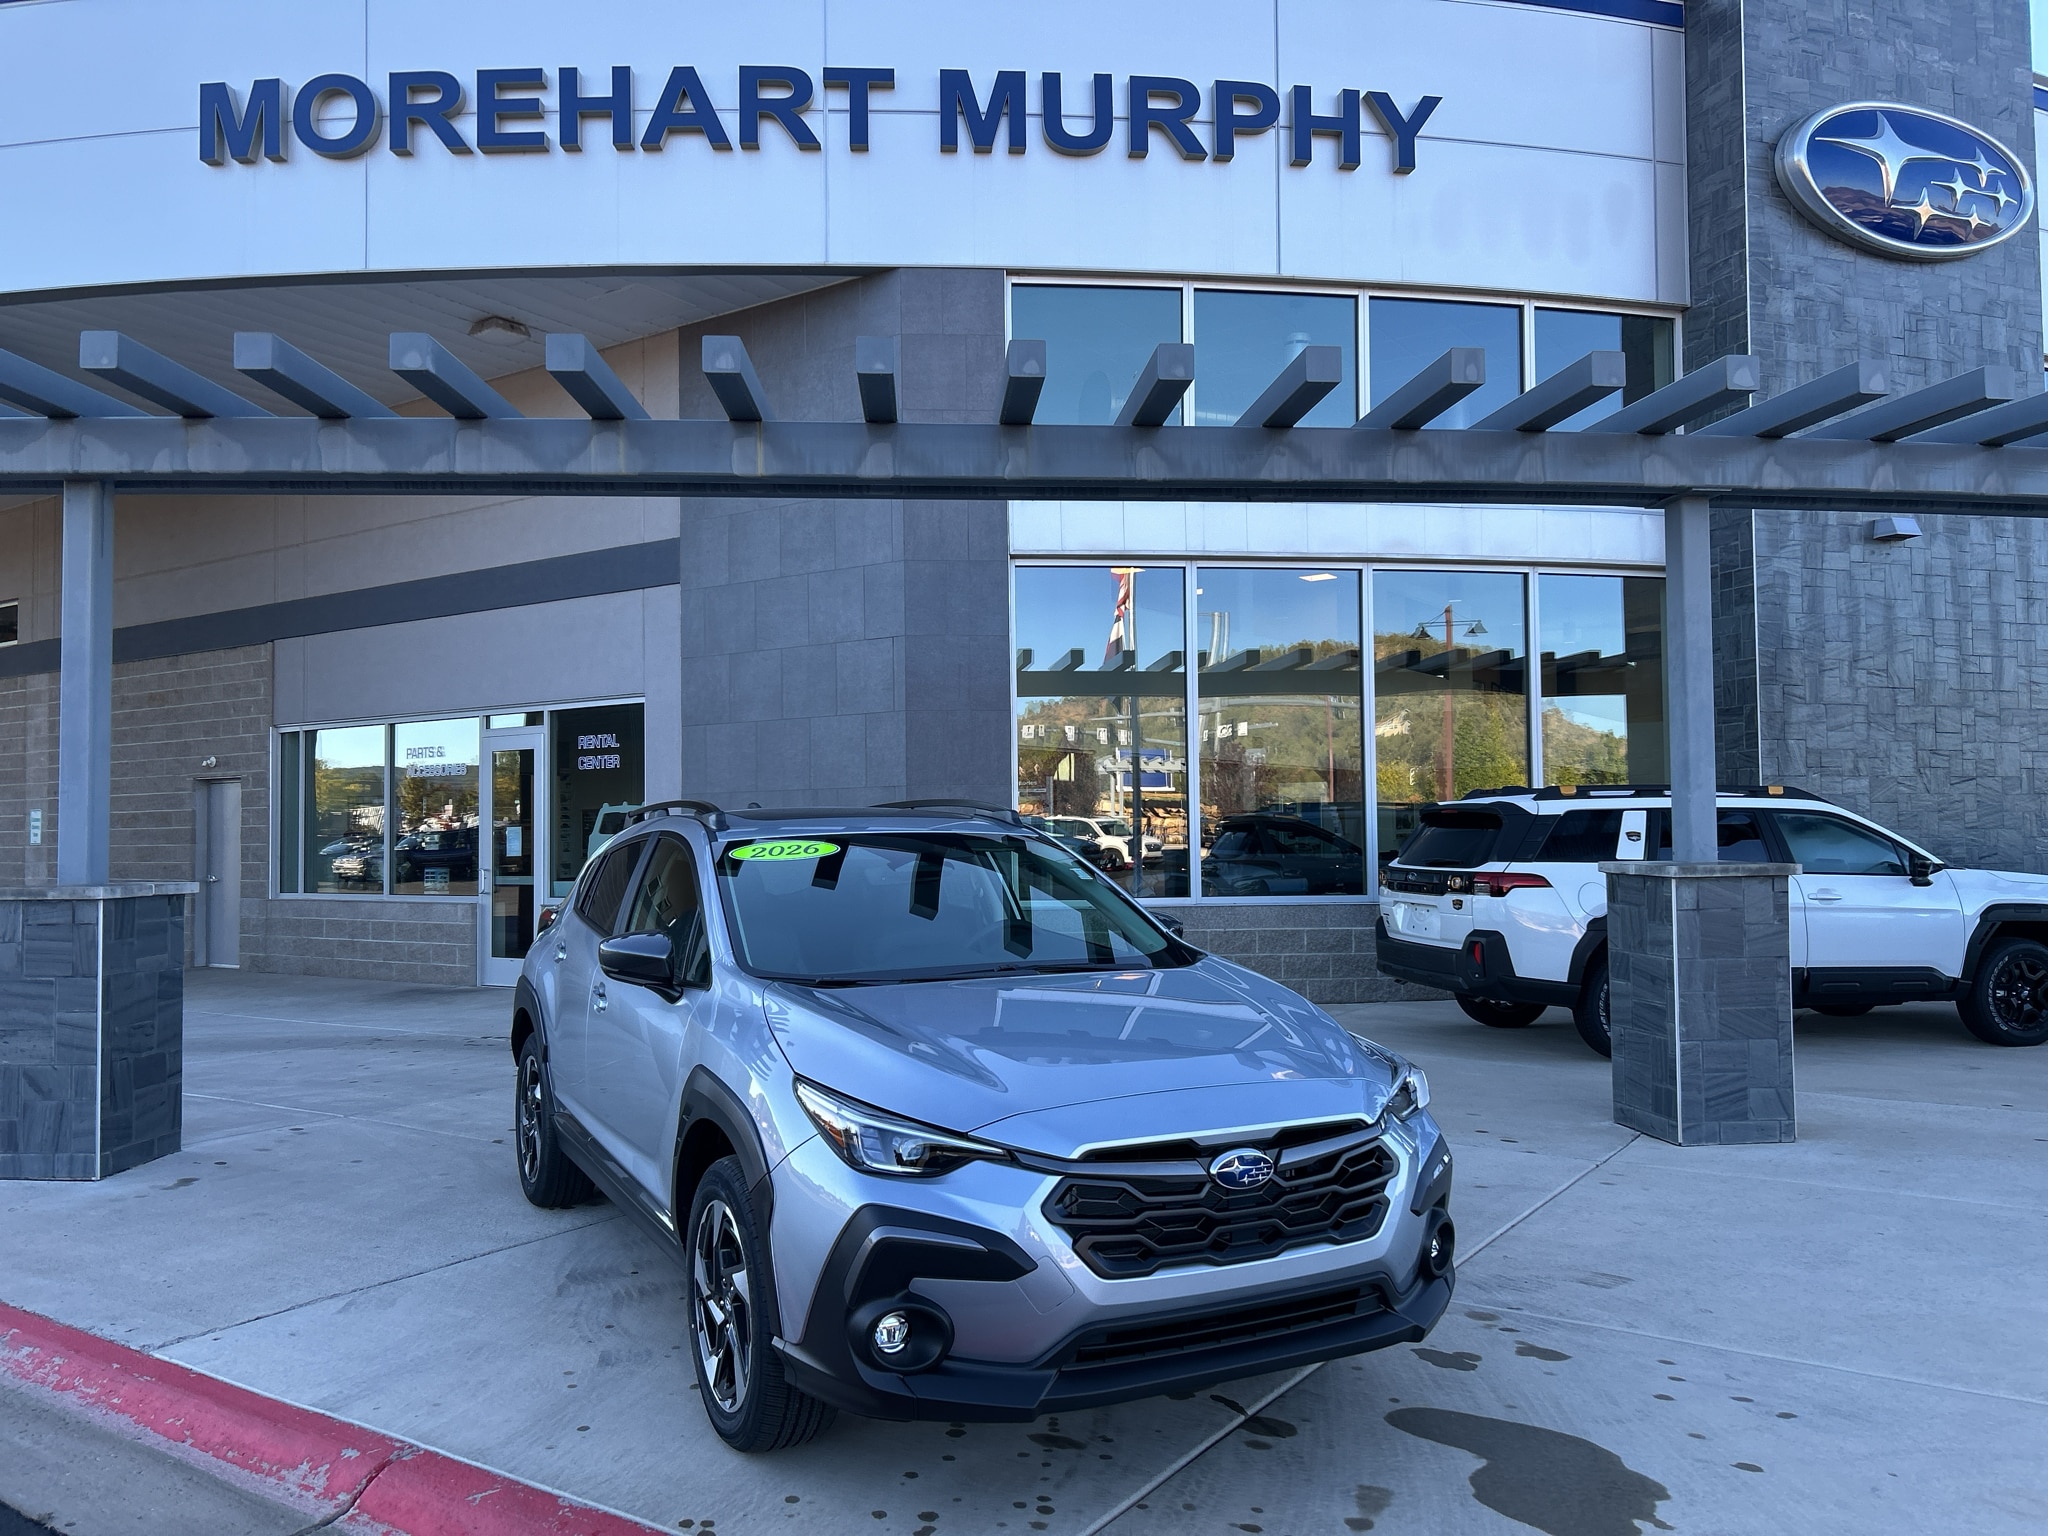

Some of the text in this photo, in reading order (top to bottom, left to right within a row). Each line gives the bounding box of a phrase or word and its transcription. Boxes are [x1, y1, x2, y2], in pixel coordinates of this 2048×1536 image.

[199, 65, 1444, 174] MOREHART MURPHY
[577, 733, 620, 750] RENTAL
[406, 746, 446, 760] PARTS &
[577, 754, 620, 770] CENTER
[750, 843, 820, 858] 2026
